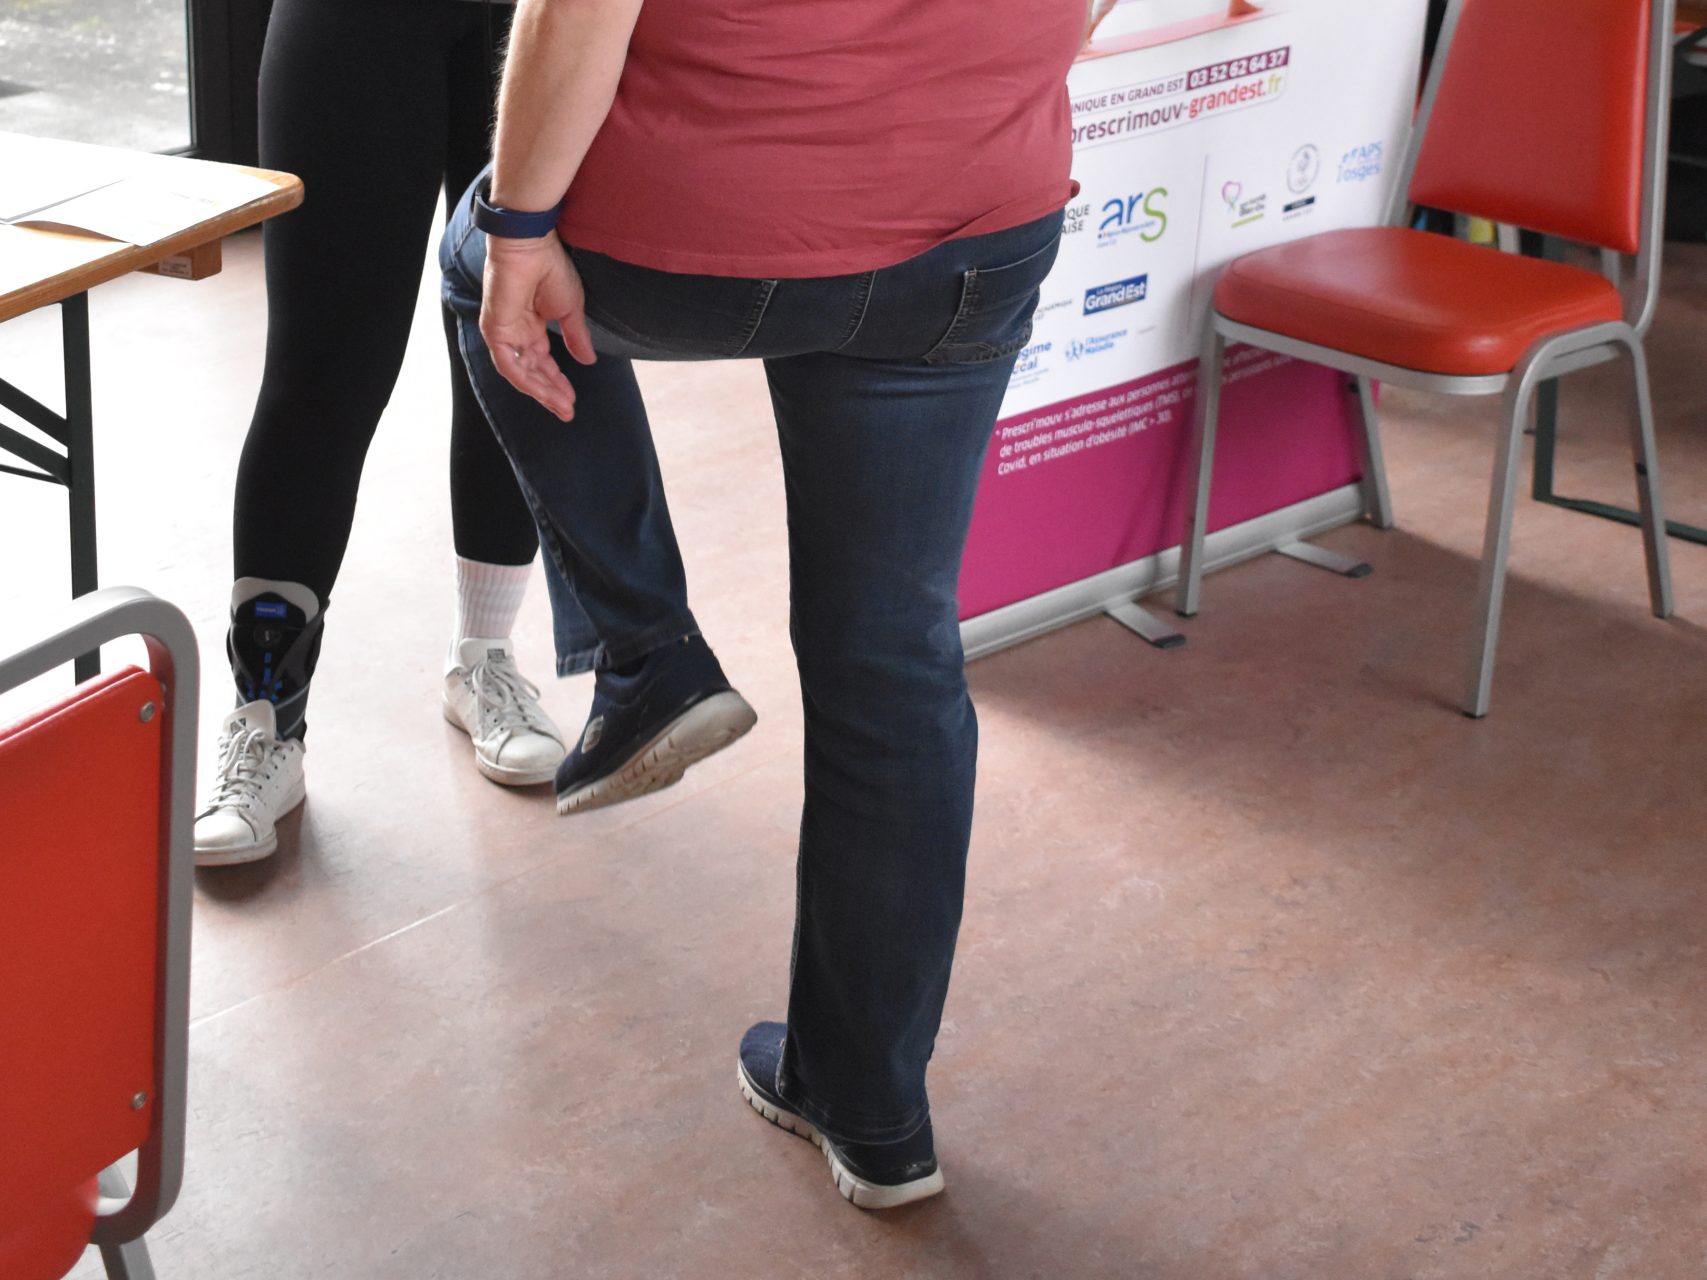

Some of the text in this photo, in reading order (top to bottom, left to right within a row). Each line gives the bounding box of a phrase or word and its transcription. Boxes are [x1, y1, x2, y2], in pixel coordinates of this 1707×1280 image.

[1110, 89, 1125, 106] EN
[1127, 81, 1165, 102] GRAND
[1166, 76, 1185, 93] EST
[1189, 69, 1209, 89] 03
[1209, 64, 1228, 83] 52
[1228, 59, 1248, 79] 62
[1248, 54, 1268, 73] 64
[1267, 49, 1287, 68] 37
[1085, 284, 1126, 311] Grand
[1126, 281, 1146, 297] Est
[1001, 413, 1064, 440] Prescri'mouv
[1064, 399, 1107, 421] s'adresse
[1108, 393, 1126, 408] aux
[1126, 378, 1170, 402] personnes
[999, 443, 1013, 458] de
[1013, 435, 1053, 454] troubles
[1028, 451, 1042, 467] en
[1042, 438, 1085, 462] situation
[1085, 424, 1128, 449] d'obésité
